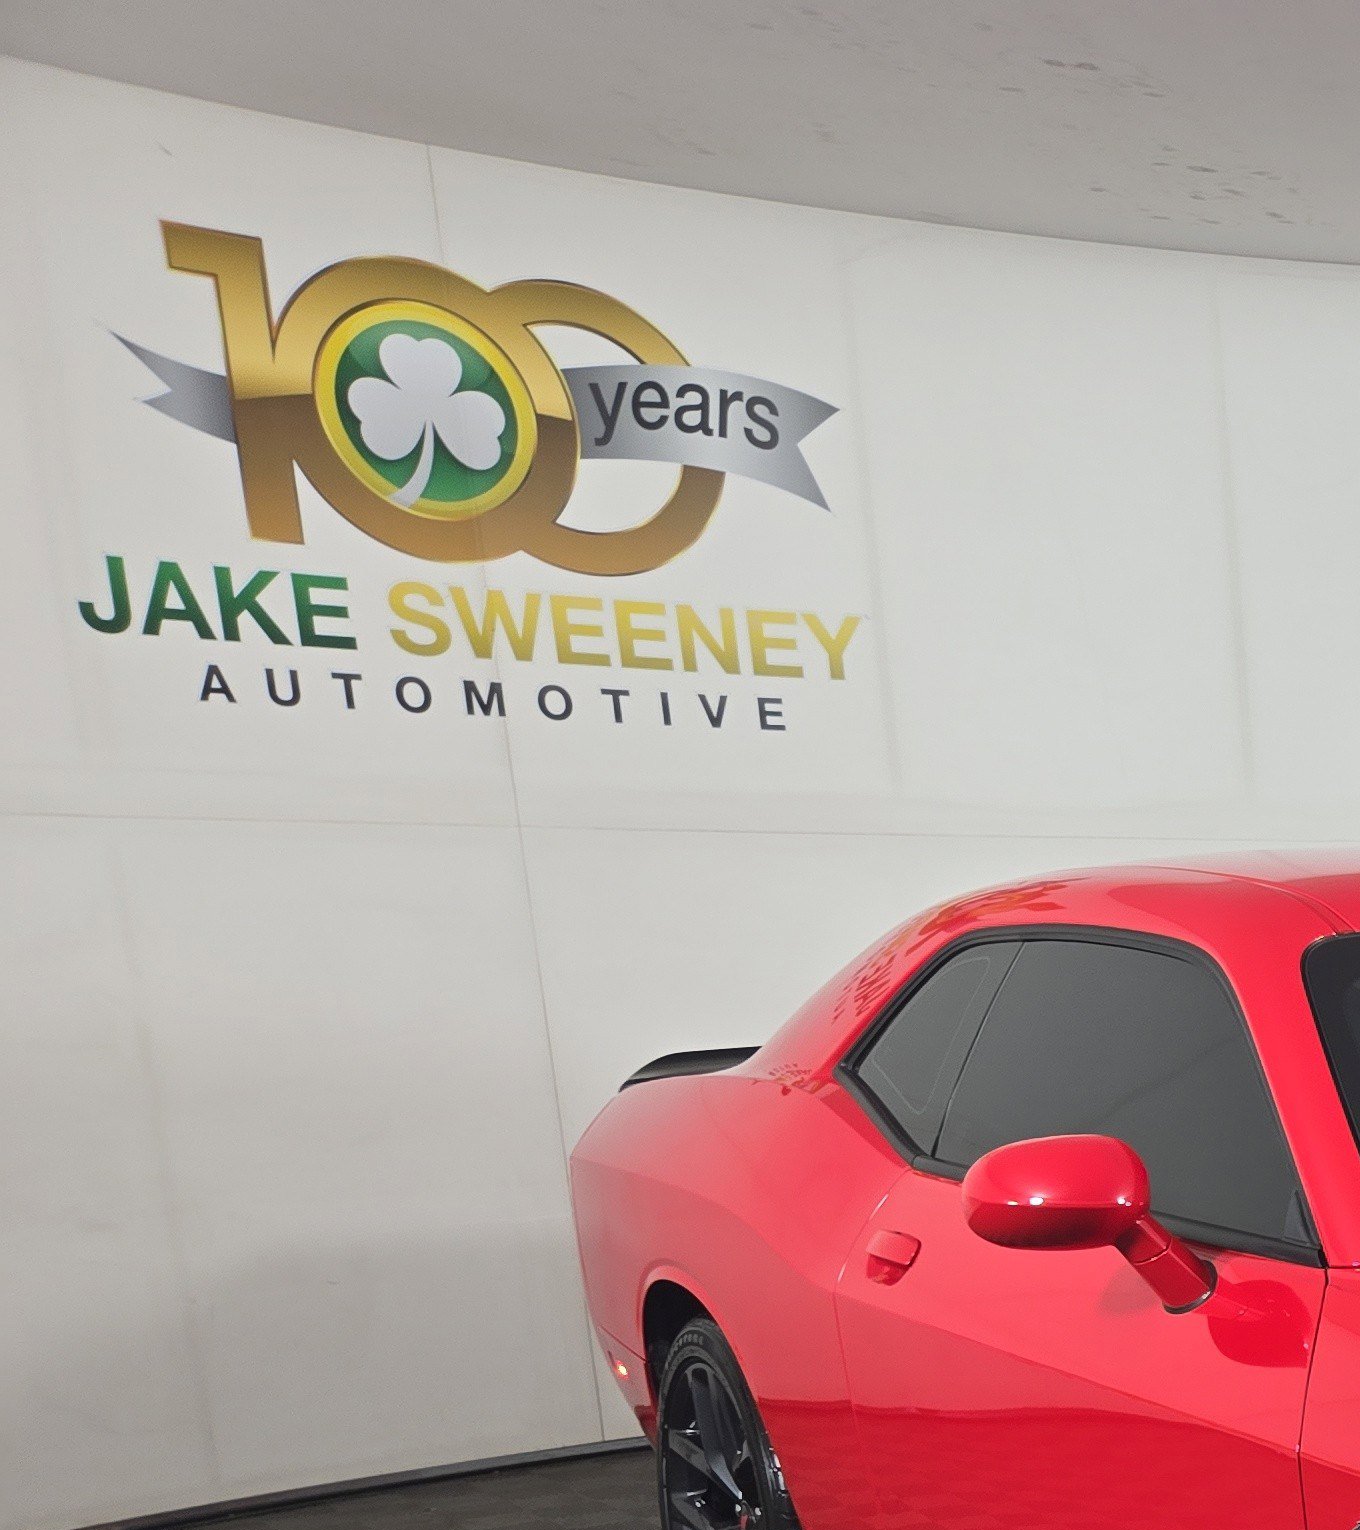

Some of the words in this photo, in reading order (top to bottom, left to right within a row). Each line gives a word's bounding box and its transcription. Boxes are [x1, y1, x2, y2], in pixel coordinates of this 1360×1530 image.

[588, 380, 780, 450] years
[78, 555, 358, 651] JAKE
[388, 582, 862, 681] SWEENEY
[200, 664, 787, 731] AUTOMOTIVE
